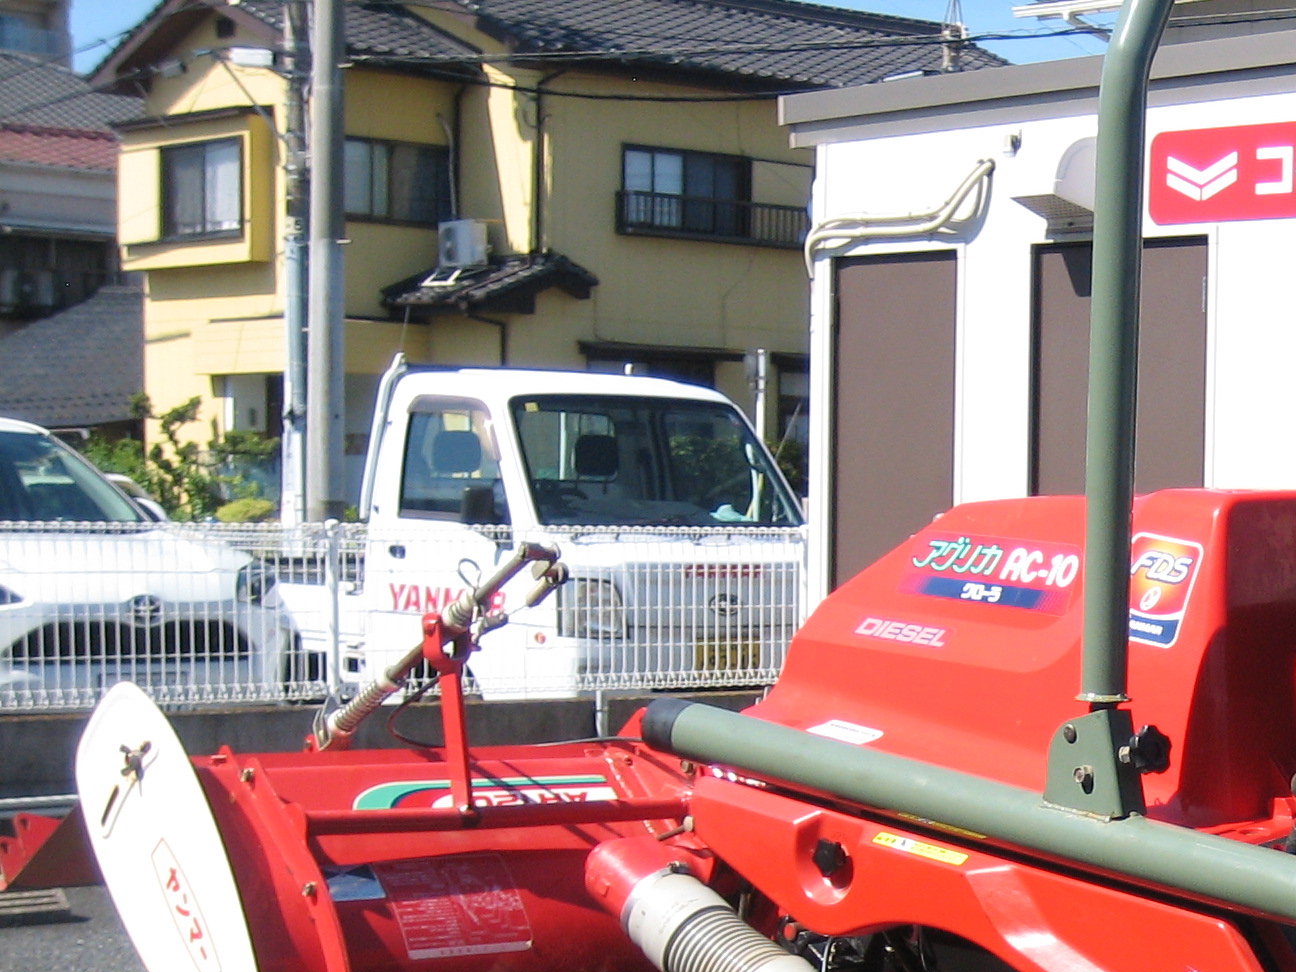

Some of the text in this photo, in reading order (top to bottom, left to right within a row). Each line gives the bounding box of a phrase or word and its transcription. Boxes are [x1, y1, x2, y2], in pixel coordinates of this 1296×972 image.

[912, 537, 1080, 588] アグリカ AC-10
[1130, 550, 1193, 585] FDS
[388, 582, 507, 618] YANMR
[960, 582, 1003, 603] クローラ
[854, 617, 946, 648] DIESEL
[166, 867, 208, 961] ヤンマー
